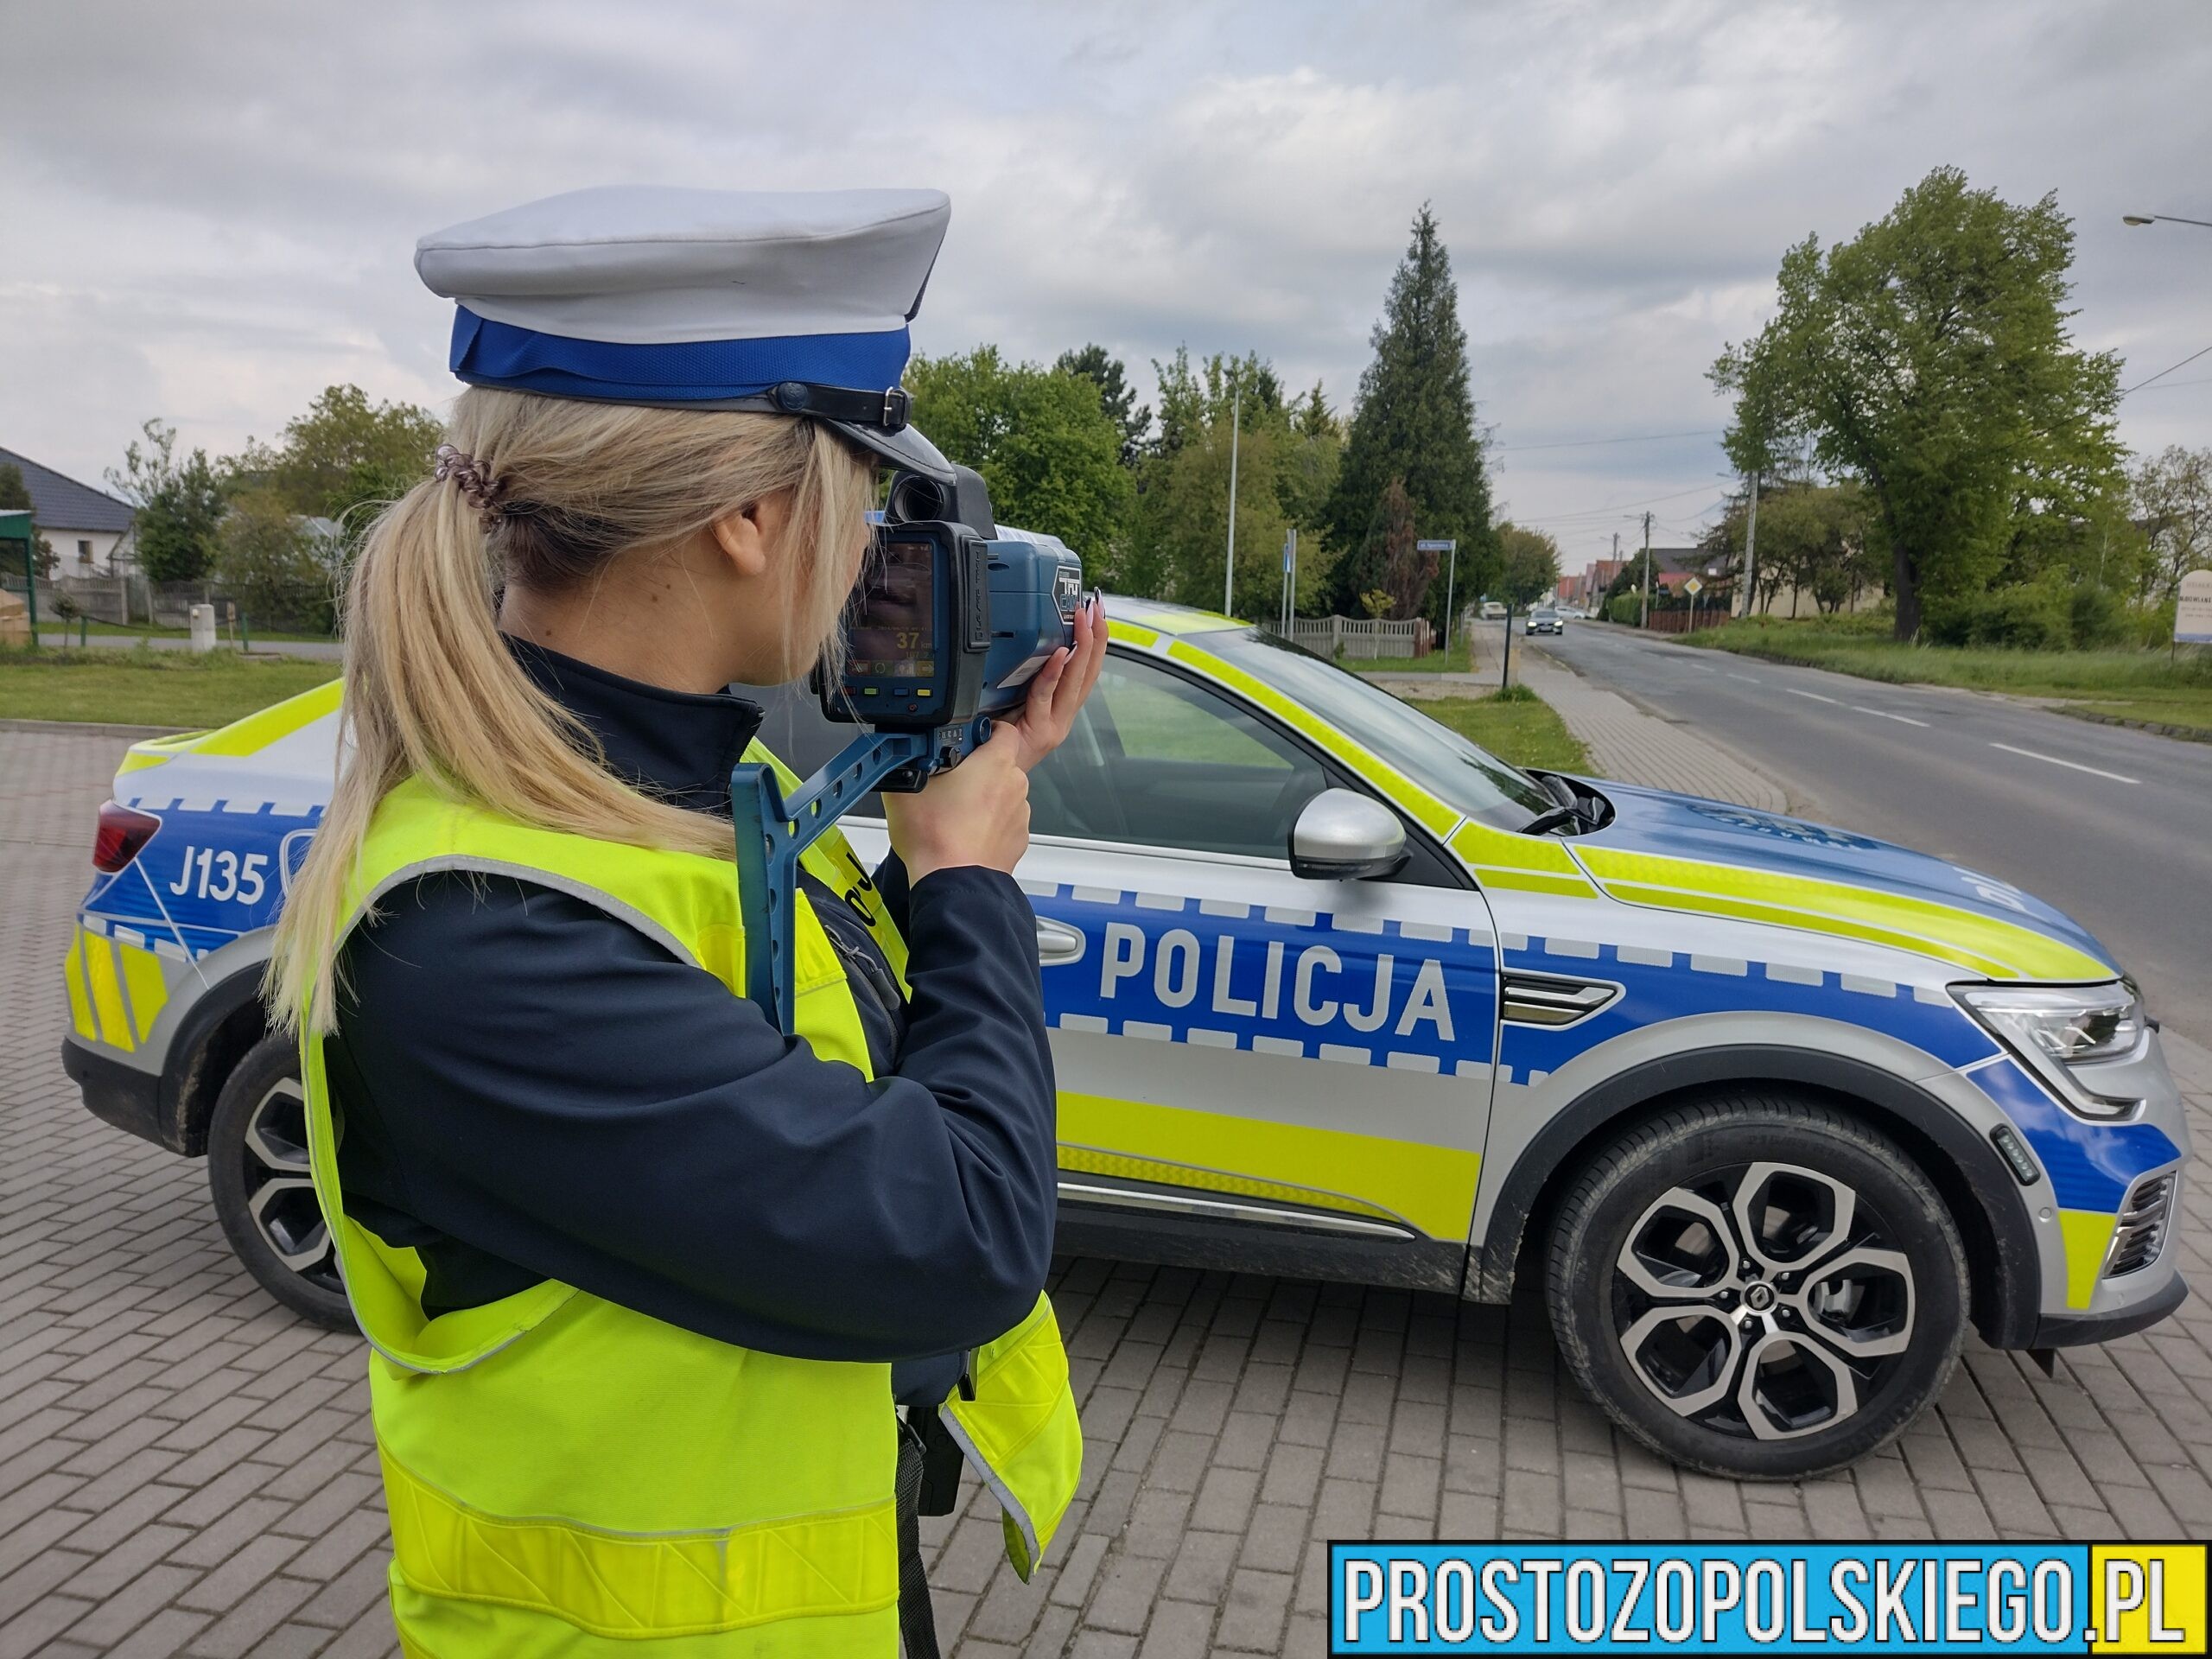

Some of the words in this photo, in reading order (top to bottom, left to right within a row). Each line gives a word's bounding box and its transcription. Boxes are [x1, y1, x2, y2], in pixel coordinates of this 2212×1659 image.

[896, 632, 920, 649] 37
[169, 845, 269, 906] J135
[1099, 921, 1455, 1042] POLICJA
